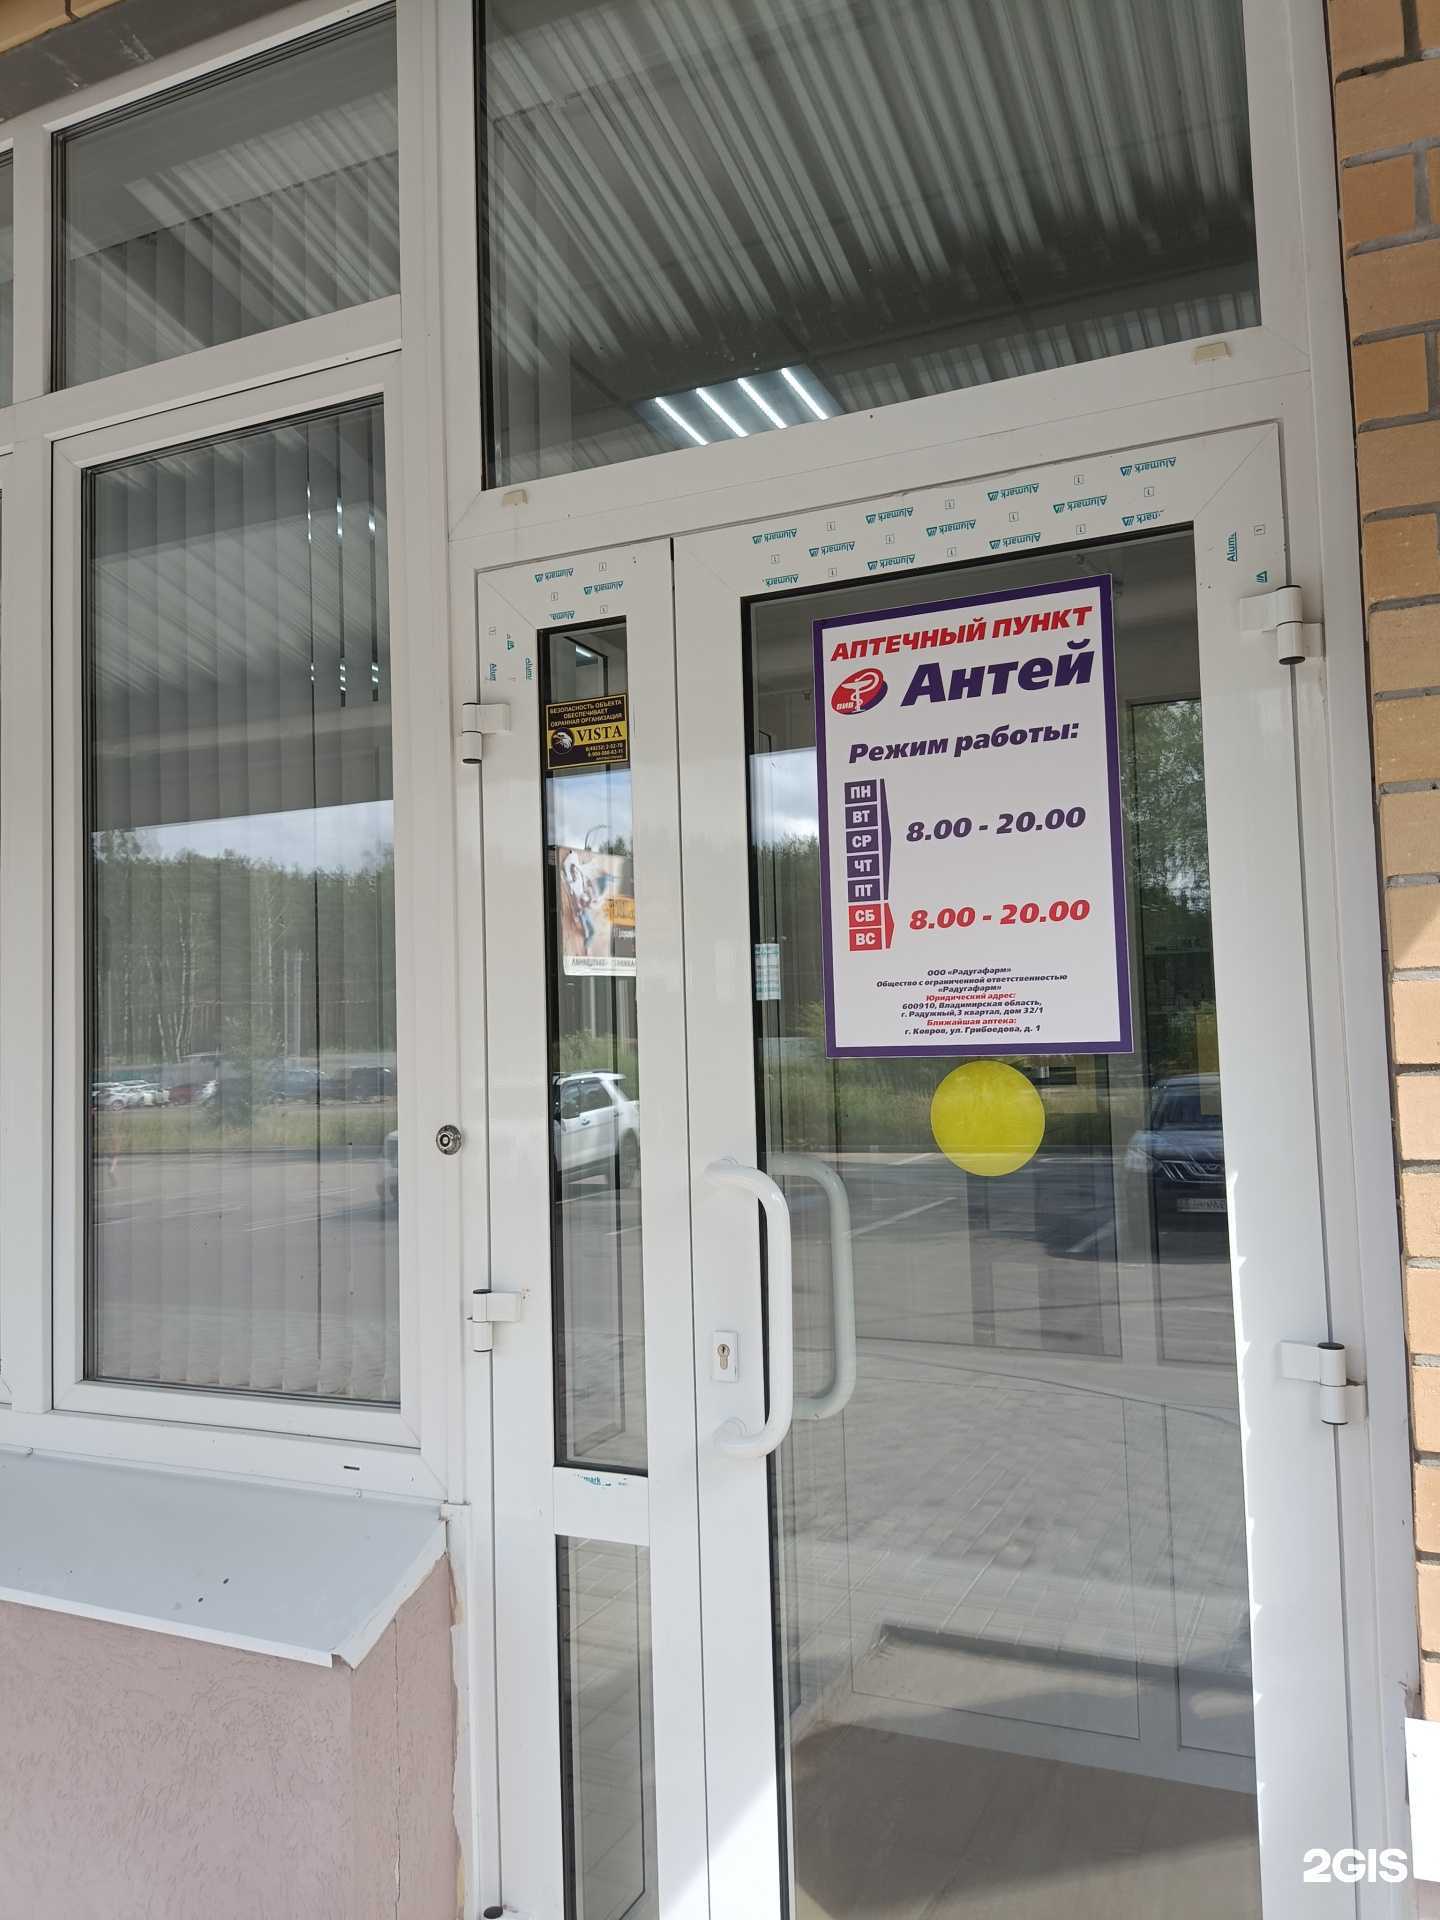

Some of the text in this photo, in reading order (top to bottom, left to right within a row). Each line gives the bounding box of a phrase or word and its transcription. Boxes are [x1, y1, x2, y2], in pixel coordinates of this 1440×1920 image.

[1135, 457, 1177, 473] Alumark
[1000, 483, 1041, 498] Alumark
[1067, 495, 1107, 511] Alumark
[878, 507, 914, 522] Alumark
[938, 519, 976, 534] Alumark
[763, 528, 798, 544] Alumark
[1002, 532, 1041, 547] Alumark
[821, 541, 855, 556] Alumark
[880, 554, 915, 569] Alumark
[830, 606, 1093, 661] АПТЕЧНЫЙ ПУНКТ
[901, 638, 1095, 708] Антей
[550, 704, 595, 714] БЕЗОПАСНОСТЬ
[563, 708, 608, 719] ОБЕСПЕЧИВАЕТ
[576, 725, 622, 742] VISTA
[849, 723, 1079, 763] Режим работы:
[850, 785, 871, 799] ПН
[852, 810, 870, 823] ВТ
[906, 817, 972, 842] 8.00
[996, 806, 1086, 834] 20.00
[852, 834, 872, 848] СР
[854, 859, 872, 872] ЧТ
[854, 884, 873, 897] ПТ
[854, 909, 876, 923] СБ
[909, 906, 975, 930] 8.00
[1000, 899, 1090, 925] 20.00
[855, 932, 876, 945] ВС
[947, 967, 1012, 977] «Радугафарм»
[876, 980, 918, 988] Общество
[924, 976, 985, 986] ограниченной
[986, 974, 1068, 983] ответственностью
[938, 985, 1002, 993] «Радугафарм»
[926, 993, 1016, 1002] Юридический адрес:
[938, 1002, 1003, 1010] Владимирская
[963, 1008, 1002, 1017] квартал,
[1003, 1008, 1022, 1016] дом
[1023, 1007, 1044, 1015] 32/1
[912, 1028, 948, 1036] Ковров,
[964, 1026, 1023, 1034] Грибоедова,
[1035, 1024, 1041, 1032] 1
